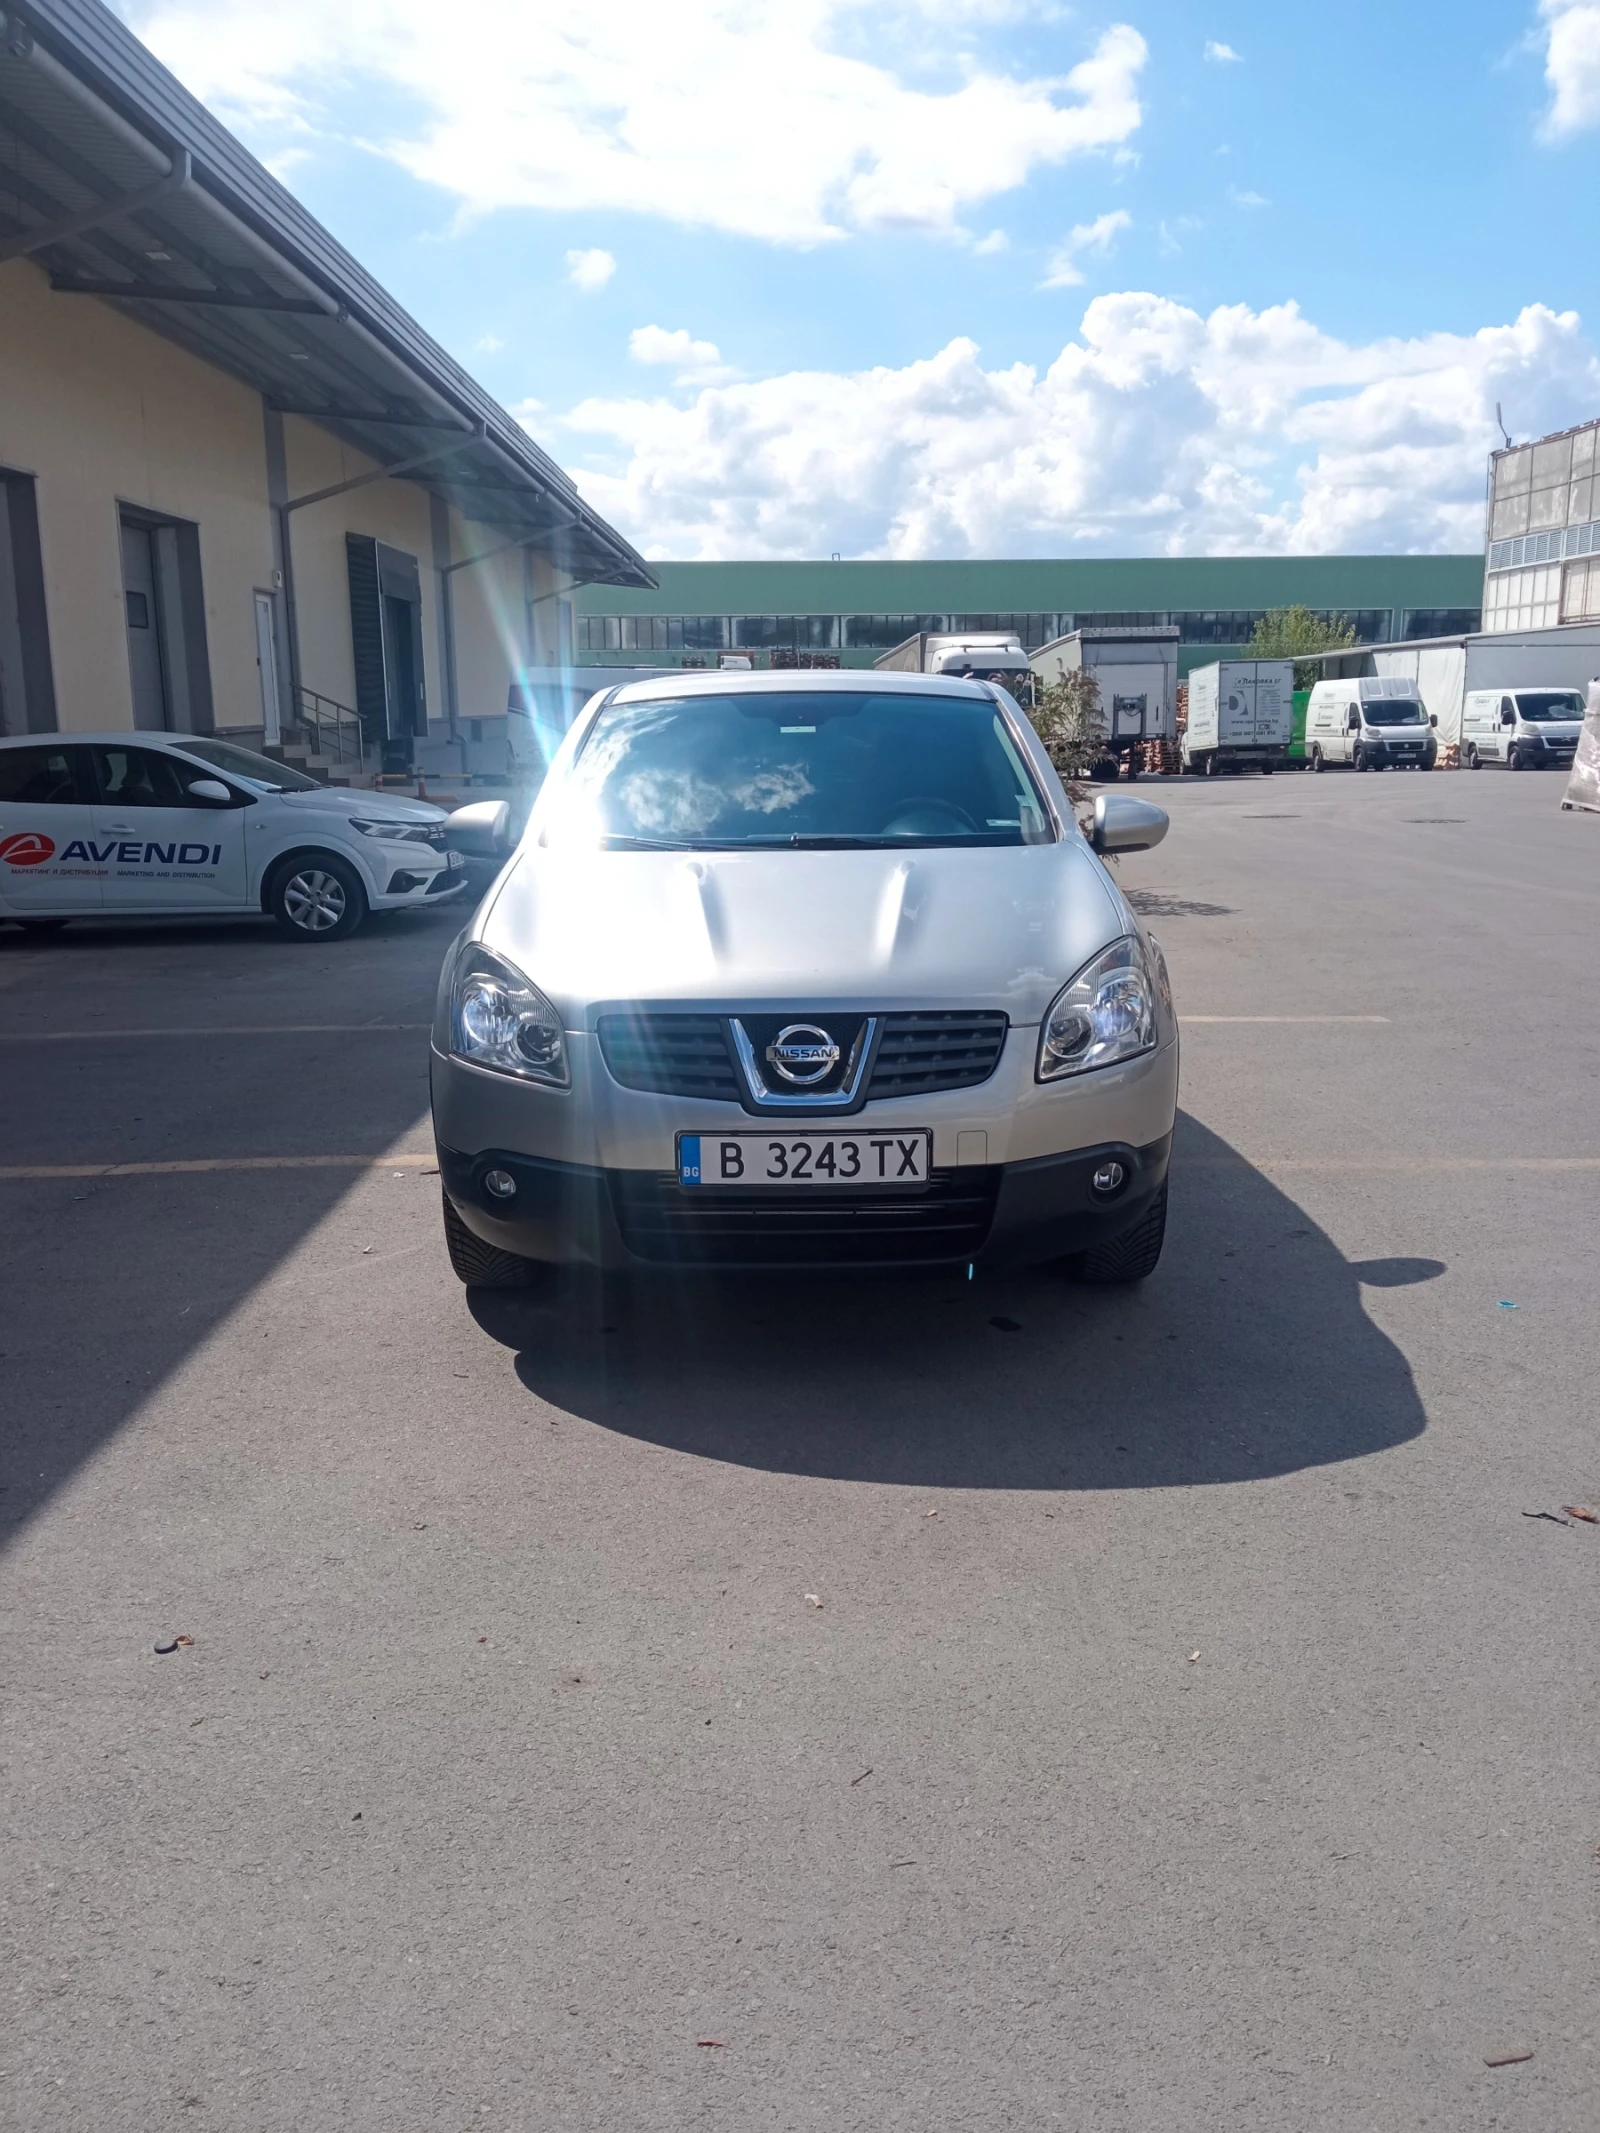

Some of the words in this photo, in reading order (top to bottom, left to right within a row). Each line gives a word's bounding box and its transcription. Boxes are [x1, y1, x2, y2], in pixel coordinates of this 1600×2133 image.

[59, 841, 222, 865] AVENDI
[774, 1049, 831, 1058] NISSAN
[683, 1166, 699, 1177] BG
[720, 1142, 745, 1178] B
[767, 1141, 861, 1179] 3243
[870, 1139, 919, 1177] TX
